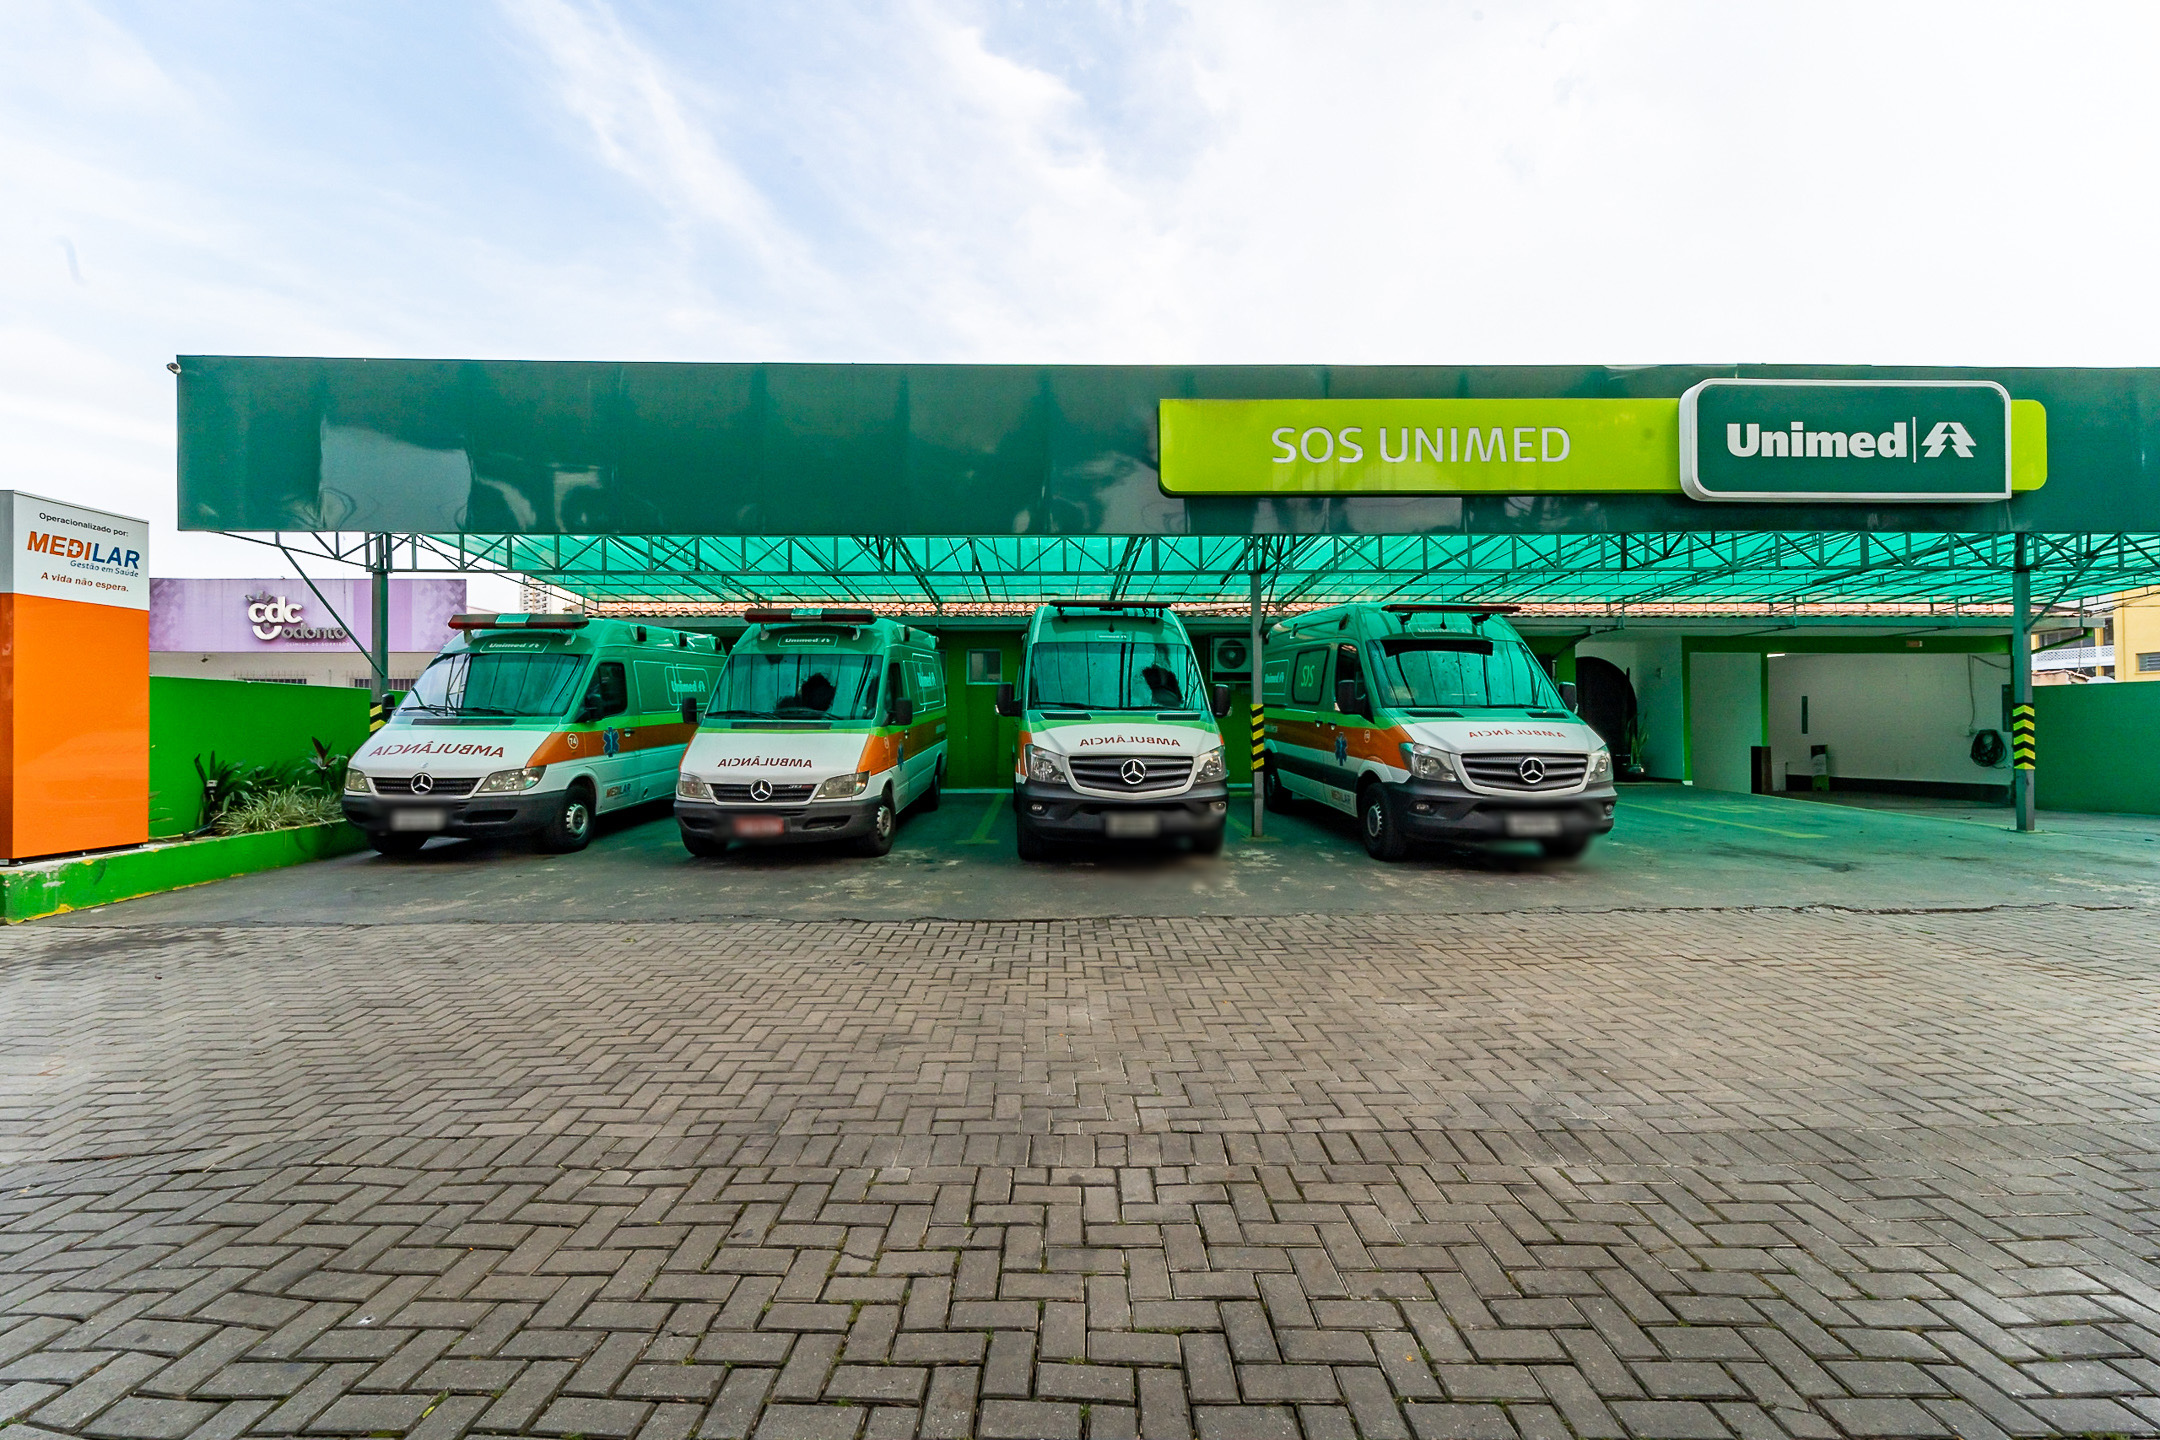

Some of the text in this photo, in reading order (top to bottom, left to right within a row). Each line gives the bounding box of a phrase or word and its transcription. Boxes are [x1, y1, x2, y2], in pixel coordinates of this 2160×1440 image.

[1271, 426, 1571, 464] SOS UNIMED
[1726, 421, 1907, 458] Unimed
[39, 512, 129, 537] Operacionalizado por:
[27, 530, 140, 570] MEDILAR
[40, 571, 129, 592] A vida não espera.
[70, 559, 100, 571] Gestão
[114, 567, 139, 578] Saúde
[247, 596, 304, 624] cdc
[281, 622, 350, 639] odonto
